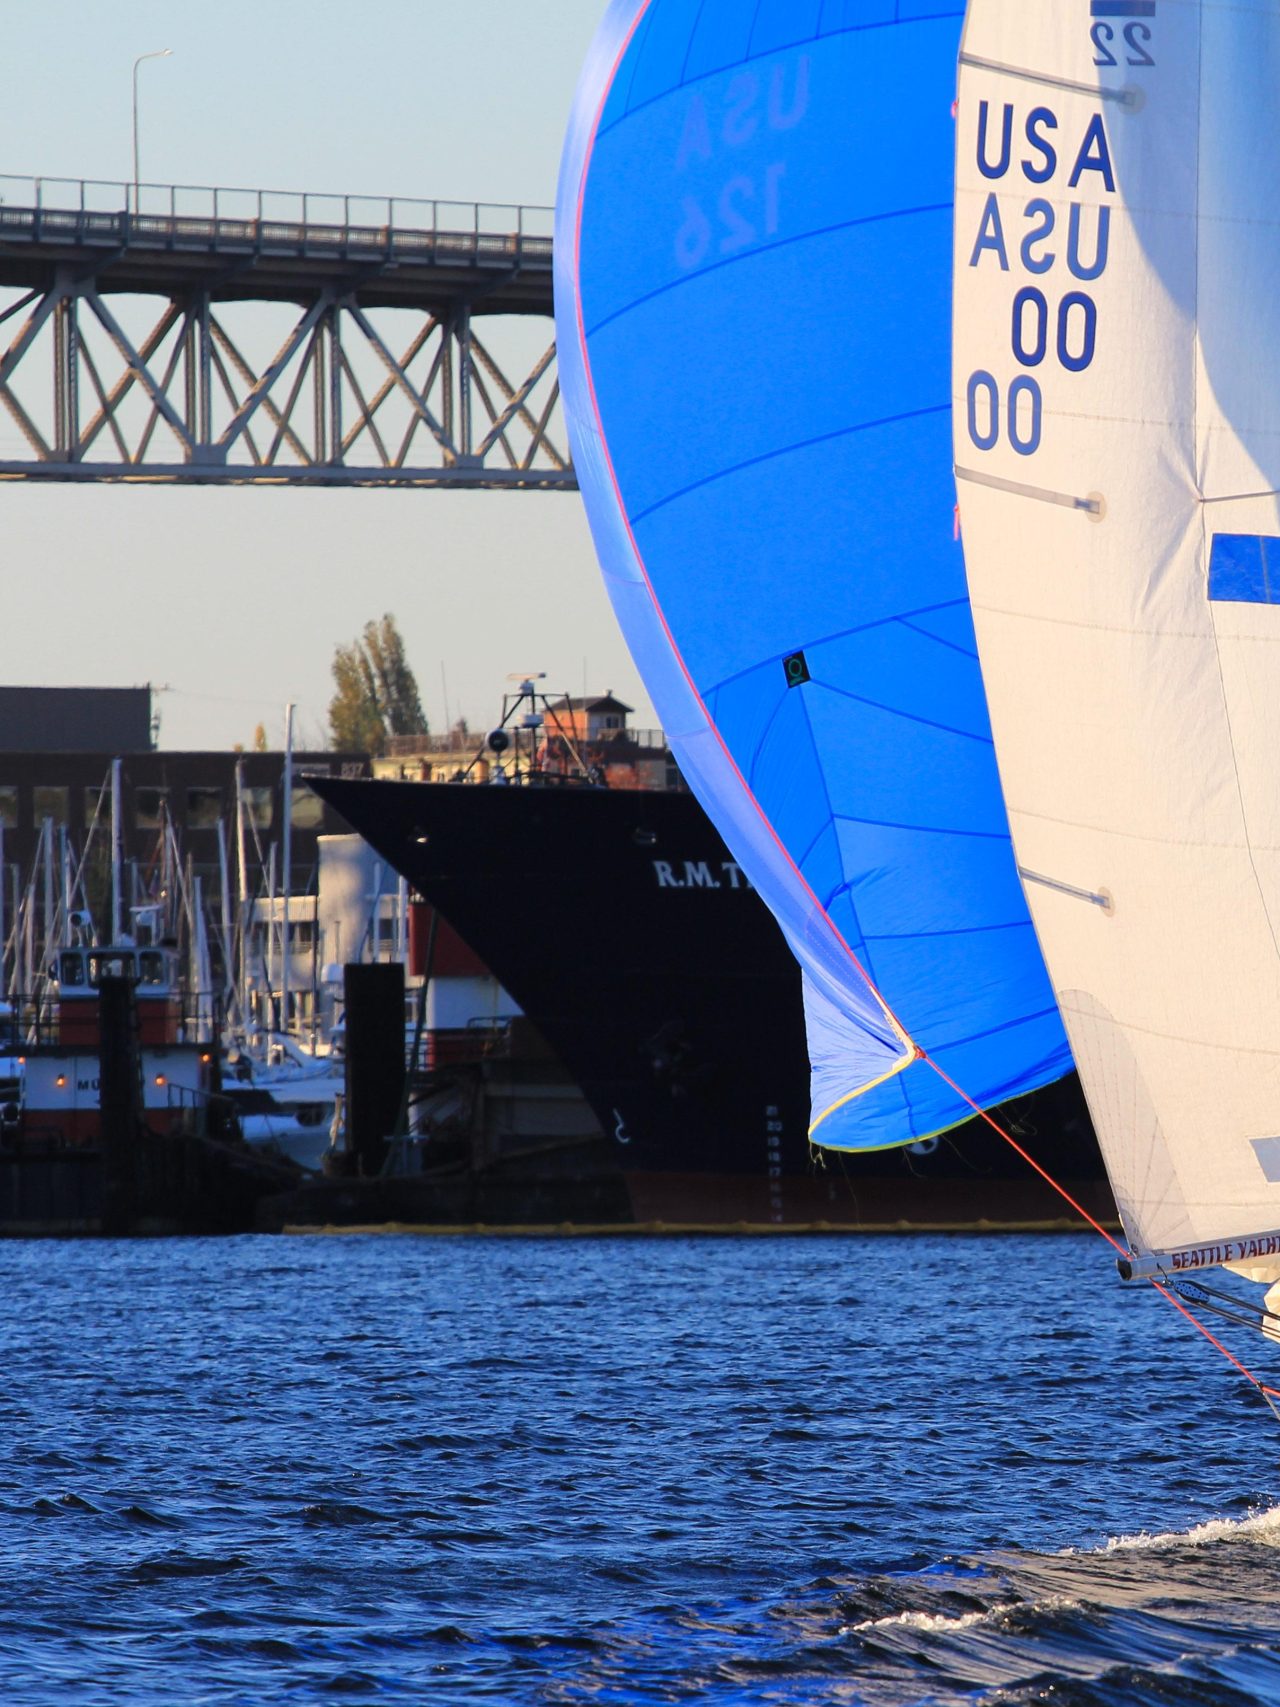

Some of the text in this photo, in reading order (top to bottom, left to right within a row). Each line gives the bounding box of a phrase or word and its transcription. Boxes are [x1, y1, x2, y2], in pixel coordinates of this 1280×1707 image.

[976, 100, 1116, 193] USA
[1011, 286, 1097, 372] 00
[653, 861, 757, 889] R.M. T
[1171, 1243, 1234, 1270] SEATTLE
